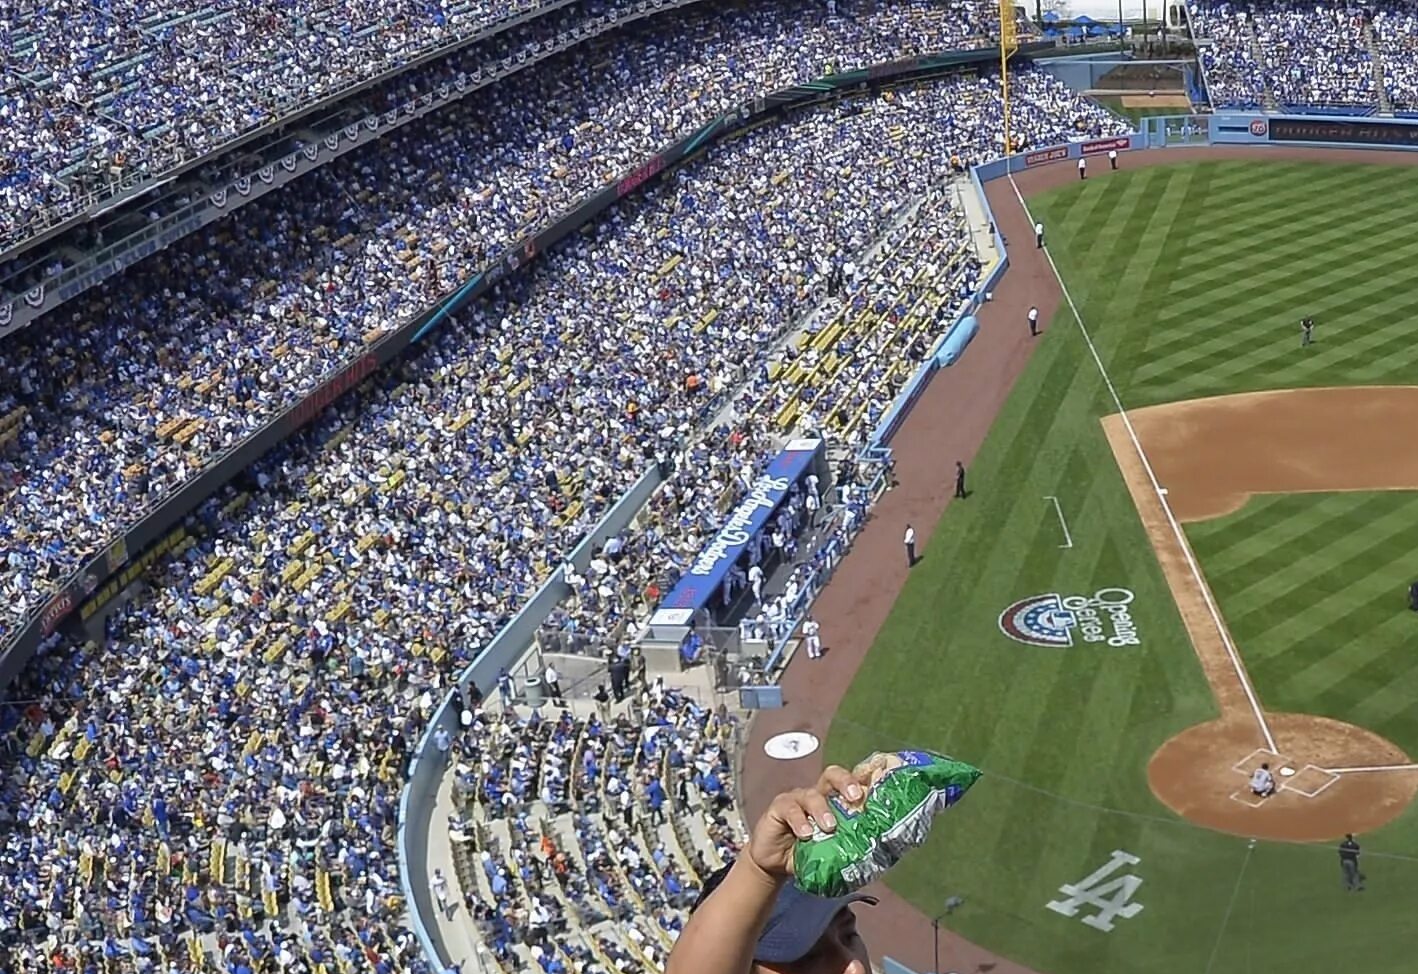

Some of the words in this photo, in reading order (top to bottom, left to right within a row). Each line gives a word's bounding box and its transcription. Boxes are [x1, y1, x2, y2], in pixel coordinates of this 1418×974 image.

[1062, 596, 1106, 642] Series
[1095, 587, 1141, 646] Opening
[1045, 849, 1144, 932] LA
